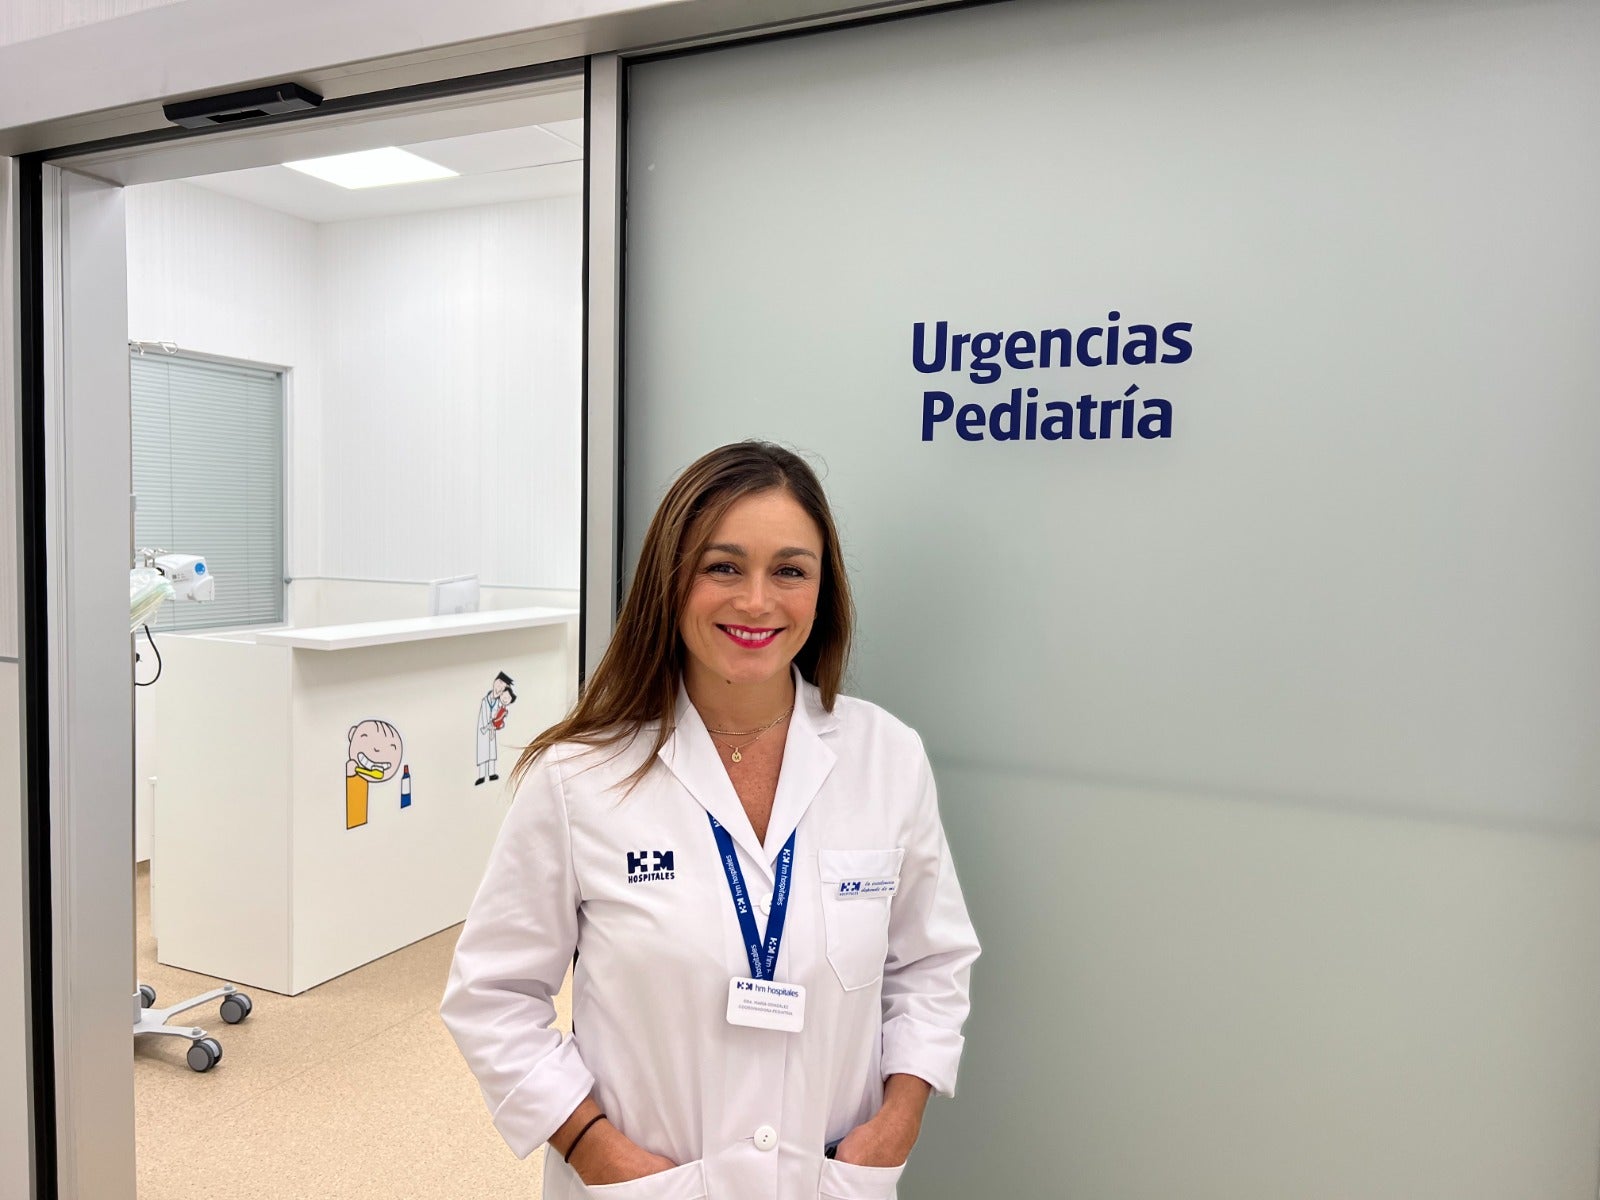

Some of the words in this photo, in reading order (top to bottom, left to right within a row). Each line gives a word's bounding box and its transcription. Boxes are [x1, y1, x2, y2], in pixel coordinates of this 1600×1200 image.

[912, 310, 1193, 384] Urgencias
[921, 383, 1173, 442] Pediatría
[628, 872, 675, 884] HOSPITALES
[726, 855, 739, 885] hospitales
[781, 864, 789, 875] hm
[735, 884, 743, 896] hm
[777, 874, 788, 906] hospitales
[750, 944, 763, 978] hospitales
[754, 984, 766, 993] hm
[767, 986, 799, 997] hospitales
